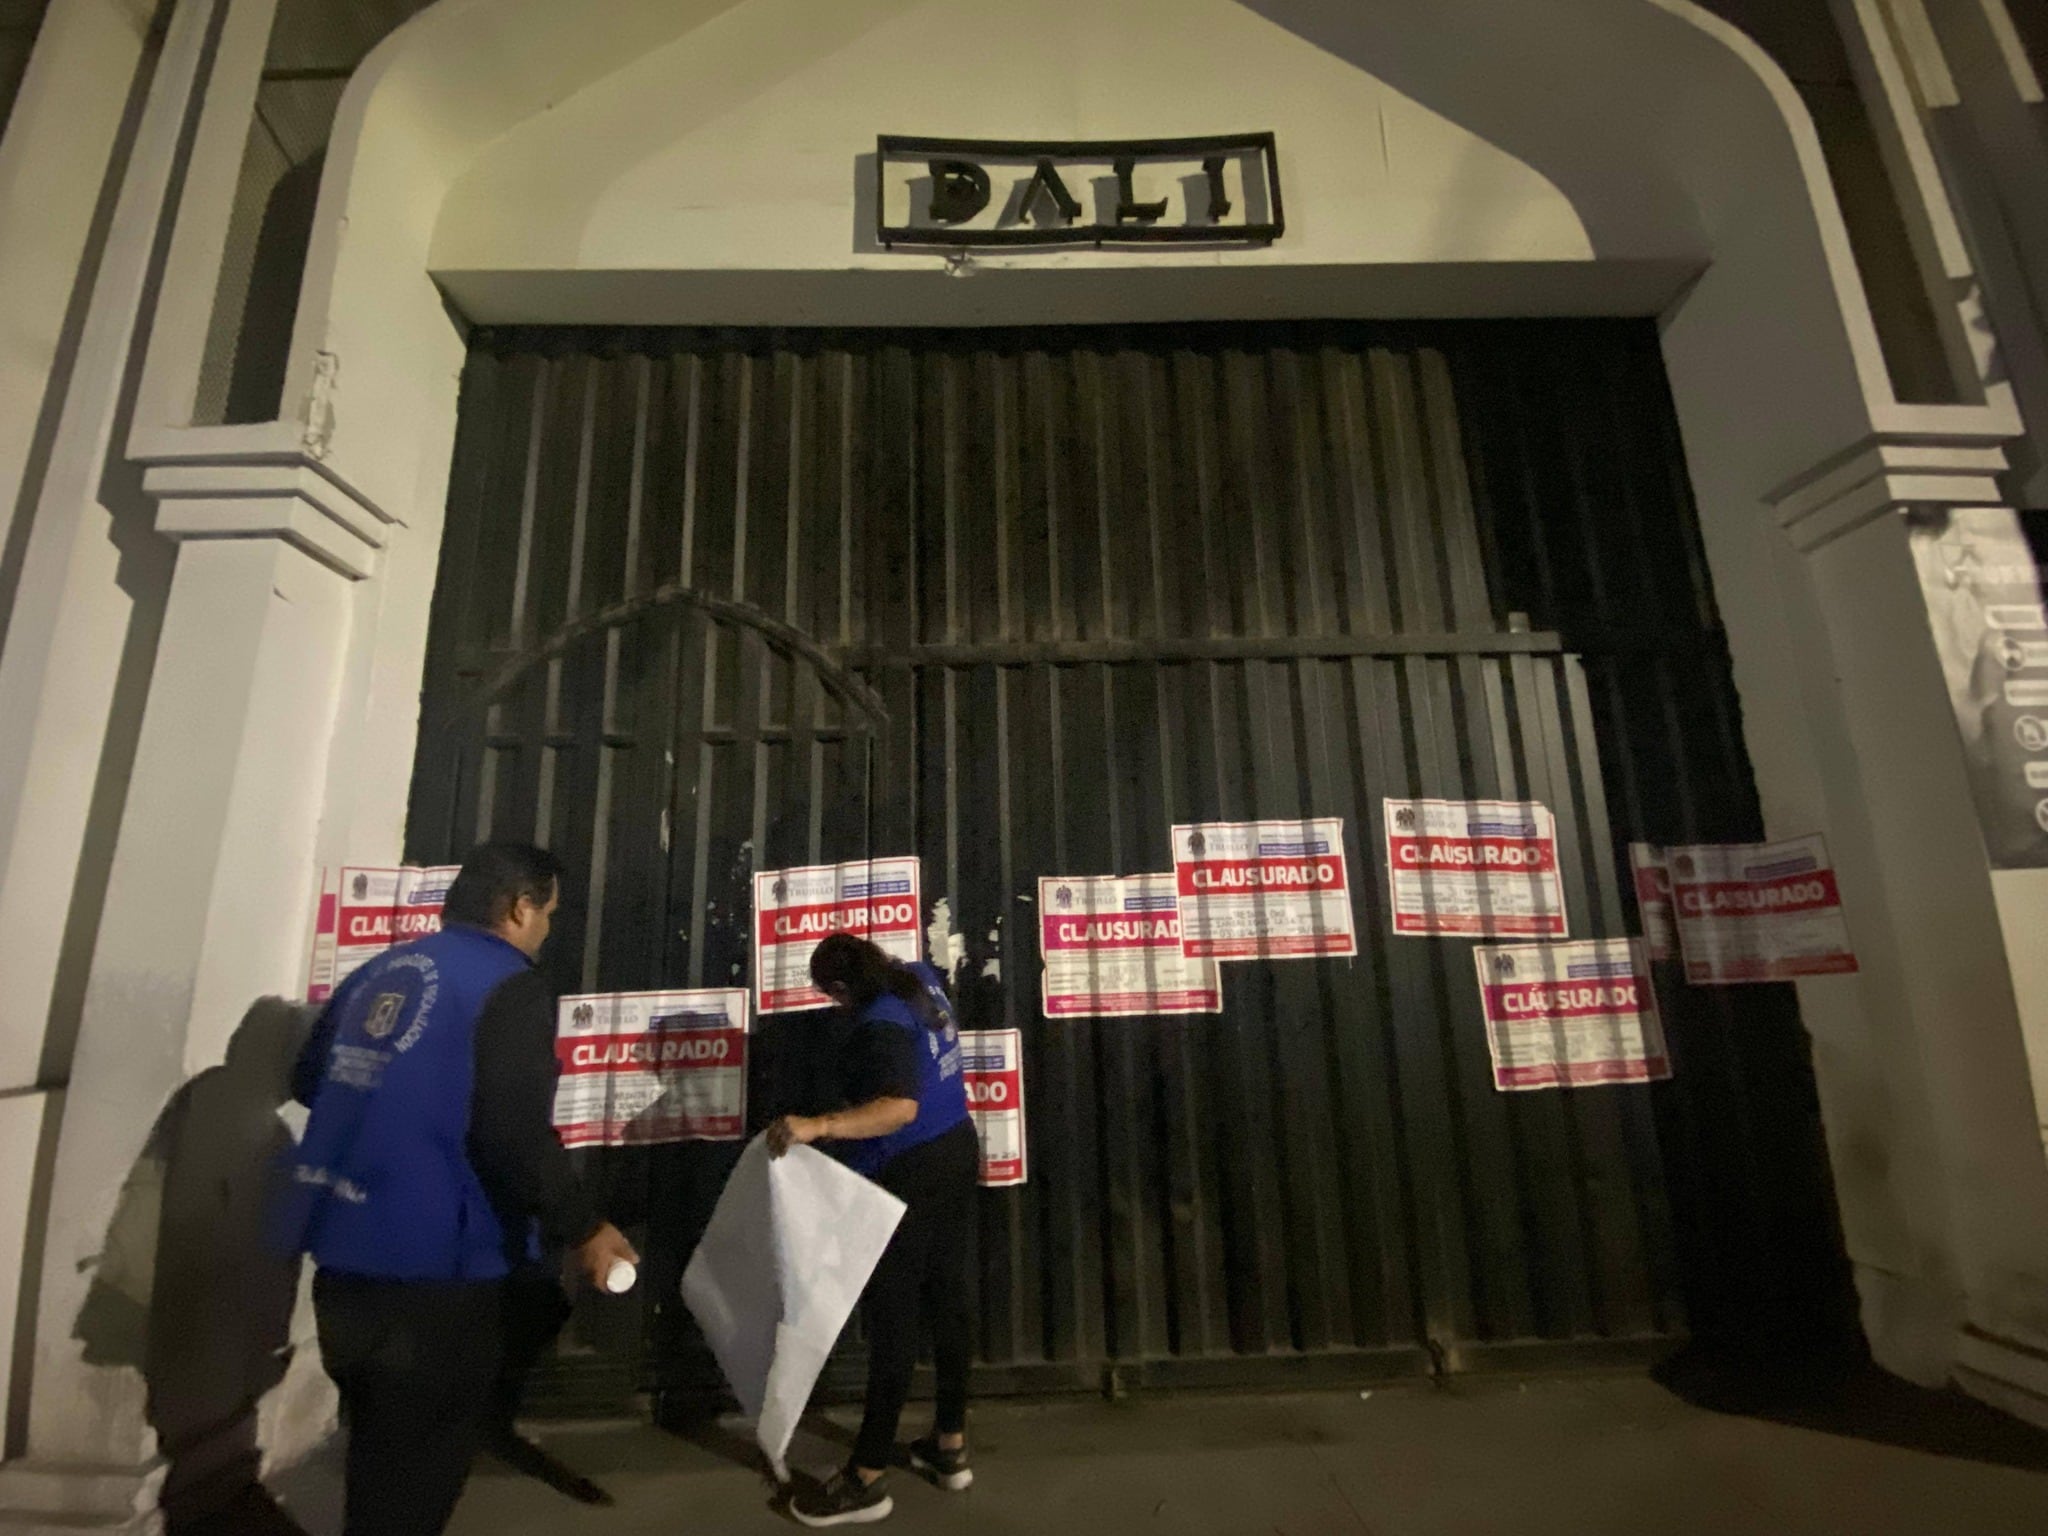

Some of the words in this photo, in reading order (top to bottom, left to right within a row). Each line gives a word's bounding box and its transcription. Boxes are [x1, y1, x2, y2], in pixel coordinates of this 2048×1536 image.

[927, 157, 1232, 224] DALI
[1400, 844, 1541, 866] CLAUSURADO
[1191, 864, 1335, 888] CLAUSURADO
[774, 903, 913, 936] CLAUSURADO
[571, 1037, 730, 1067] CLAUSURADO
